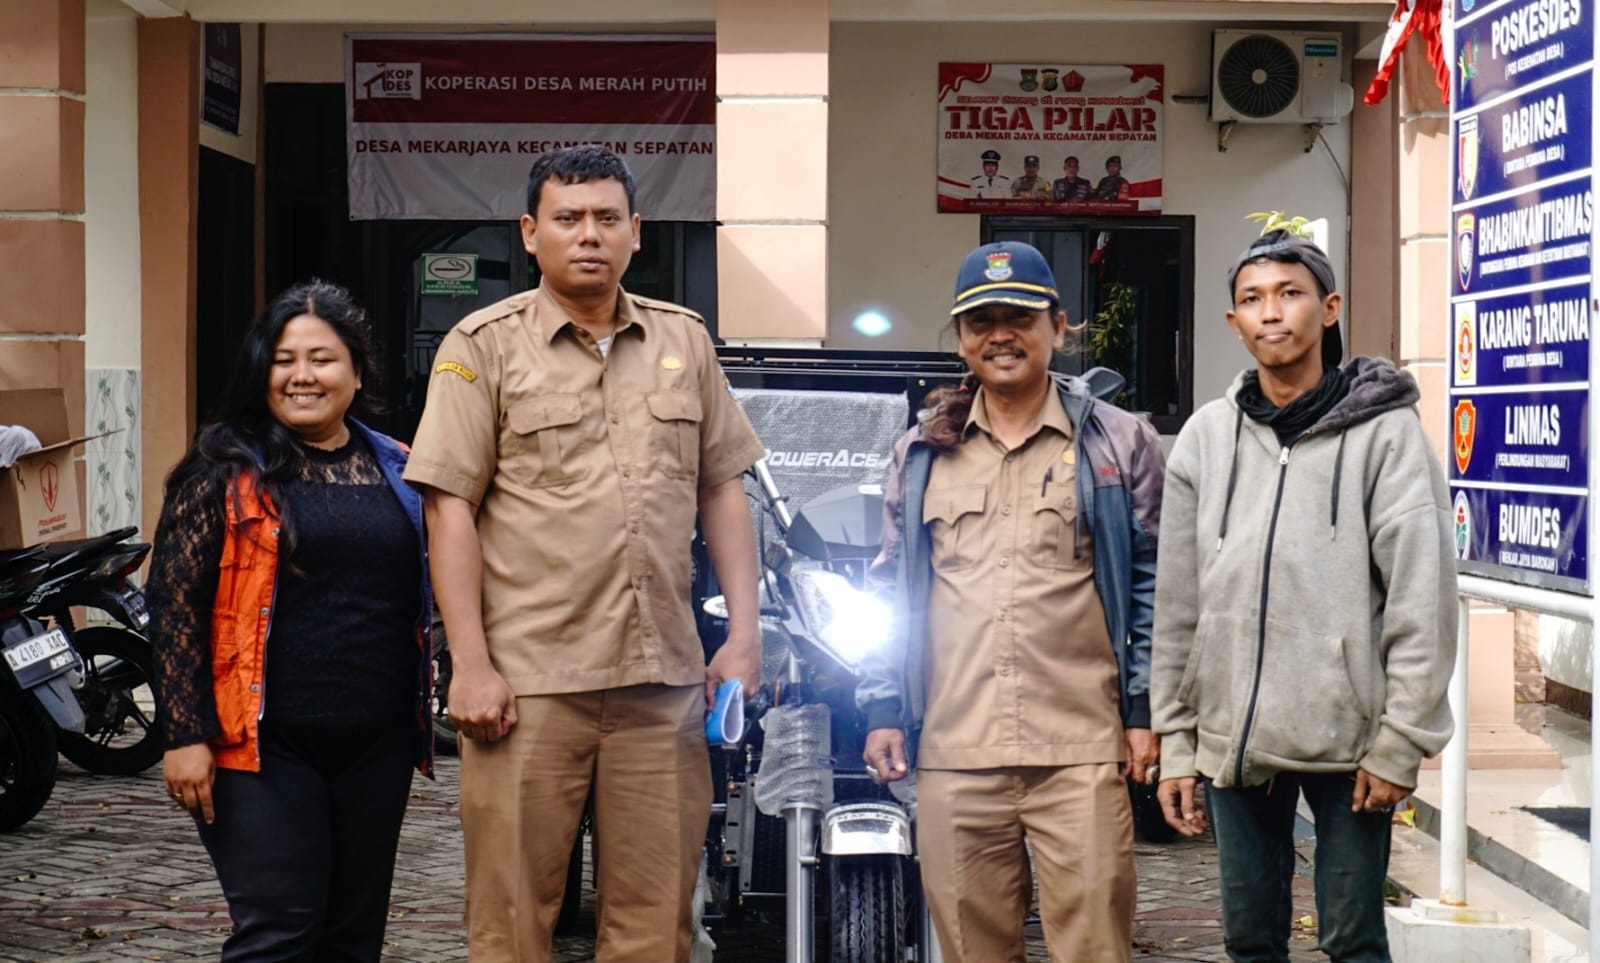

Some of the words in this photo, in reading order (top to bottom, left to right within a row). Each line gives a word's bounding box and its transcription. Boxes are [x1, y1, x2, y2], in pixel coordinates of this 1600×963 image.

[1492, 0, 1581, 60] POSKESDES
[386, 69, 413, 79] KOP
[386, 81, 411, 91] DES
[425, 76, 517, 91] KOPERASI
[524, 76, 573, 91] DESA
[579, 77, 645, 91] MERAH
[652, 78, 707, 92] PUTIH
[944, 105, 1034, 131] TIGA
[1043, 107, 1157, 132] PILAR
[1502, 93, 1567, 152] BABINSA
[356, 139, 402, 153] DESA
[408, 140, 511, 157] MEKARJAYA
[517, 140, 627, 155] KECAMAN
[634, 141, 713, 155] SEPATAN
[945, 131, 973, 140] DESA
[975, 131, 1012, 141] MEKAR
[1014, 132, 1041, 141] JAYA
[1043, 132, 1107, 142] KECAMATAN
[1108, 132, 1157, 142] SEPATAN
[1479, 306, 1531, 350] KARANG
[1533, 298, 1589, 344] TARUNA
[1504, 404, 1560, 446] LINMAS
[1498, 503, 1561, 549] BUMDES
[7, 653, 19, 668] A
[19, 641, 45, 661] 4180
[46, 633, 67, 651] XAC
